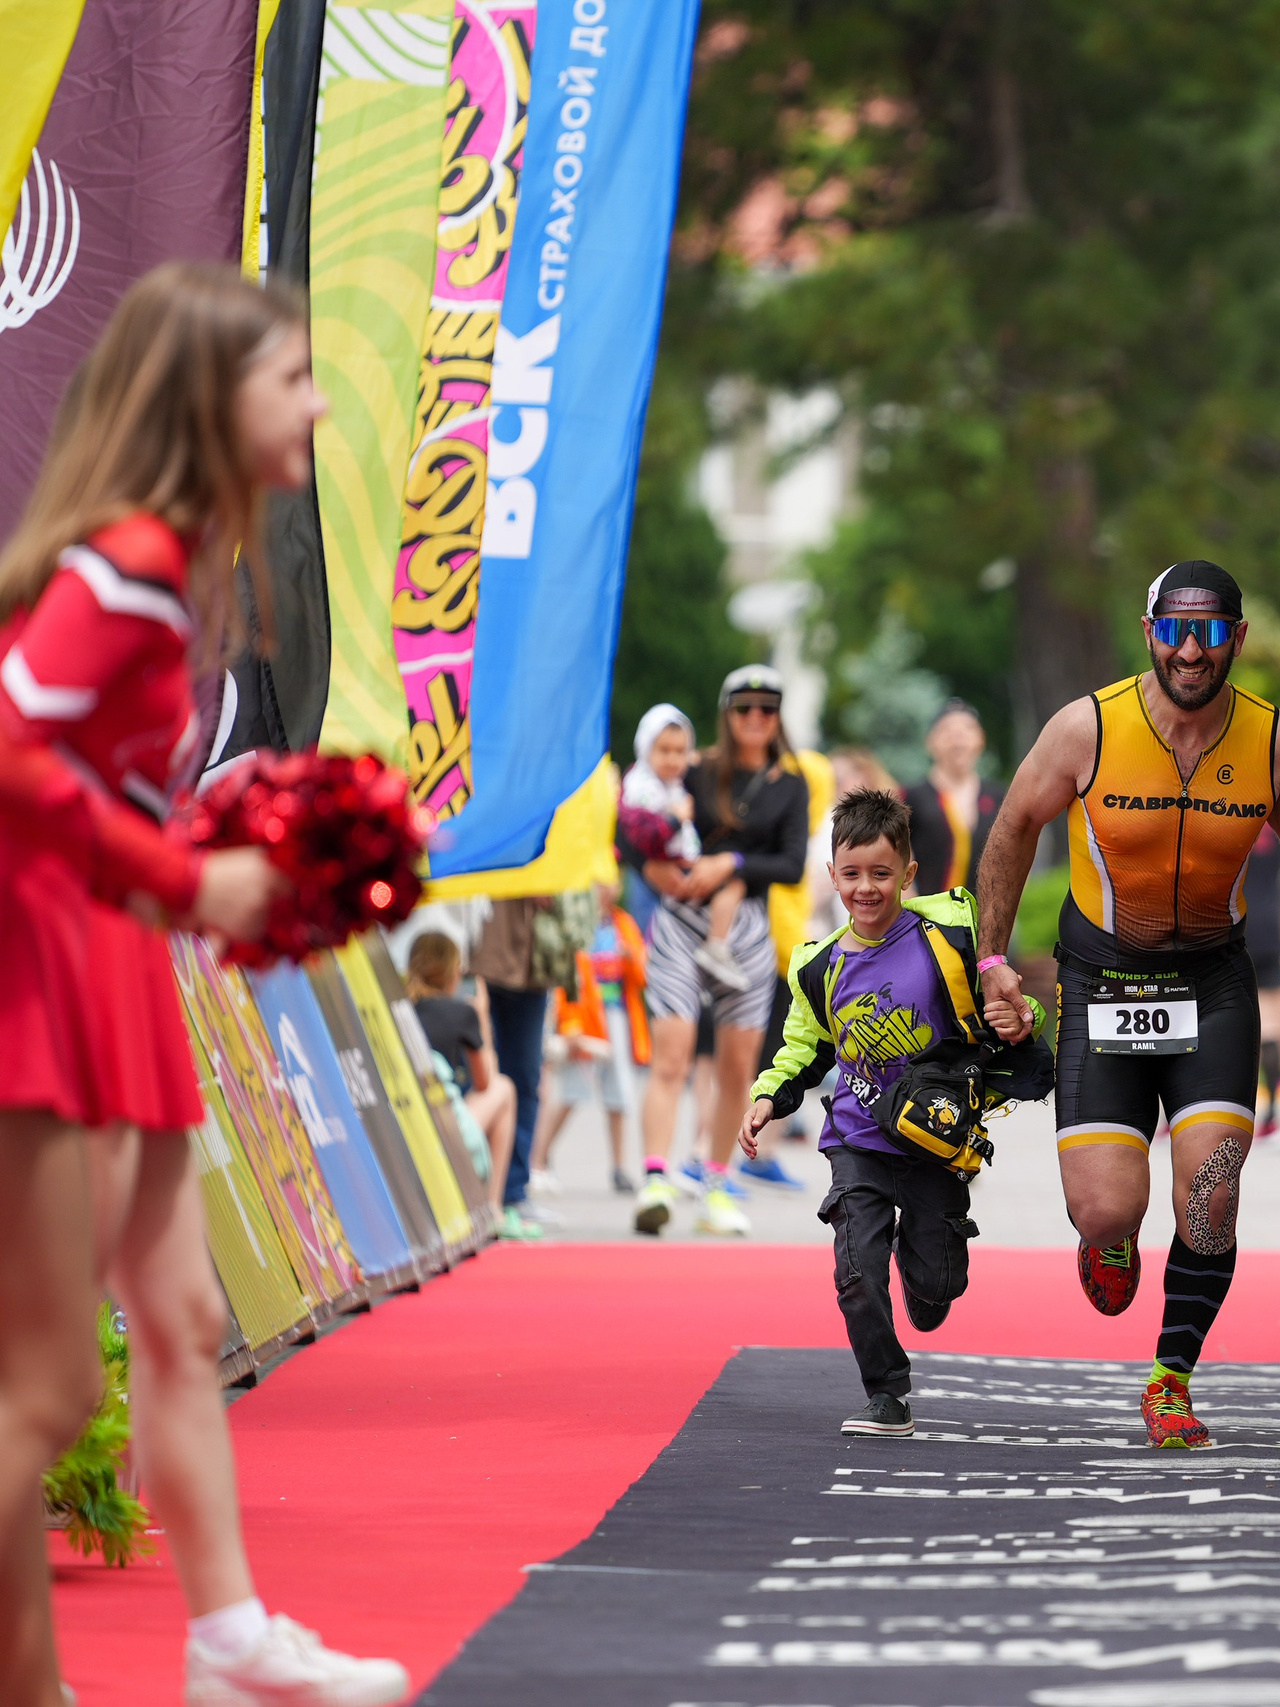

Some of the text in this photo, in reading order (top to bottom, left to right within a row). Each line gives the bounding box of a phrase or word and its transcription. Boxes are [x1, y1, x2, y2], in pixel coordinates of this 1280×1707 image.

[480, 313, 561, 559] ВСК
[537, 66, 597, 310] СТРАХОВОЙ
[1103, 794, 1267, 818] СТАВРОПОЛИС
[1124, 984, 1158, 993] IRON STAR
[1116, 1009, 1170, 1035] 280
[1132, 1042, 1156, 1050] RAMIL
